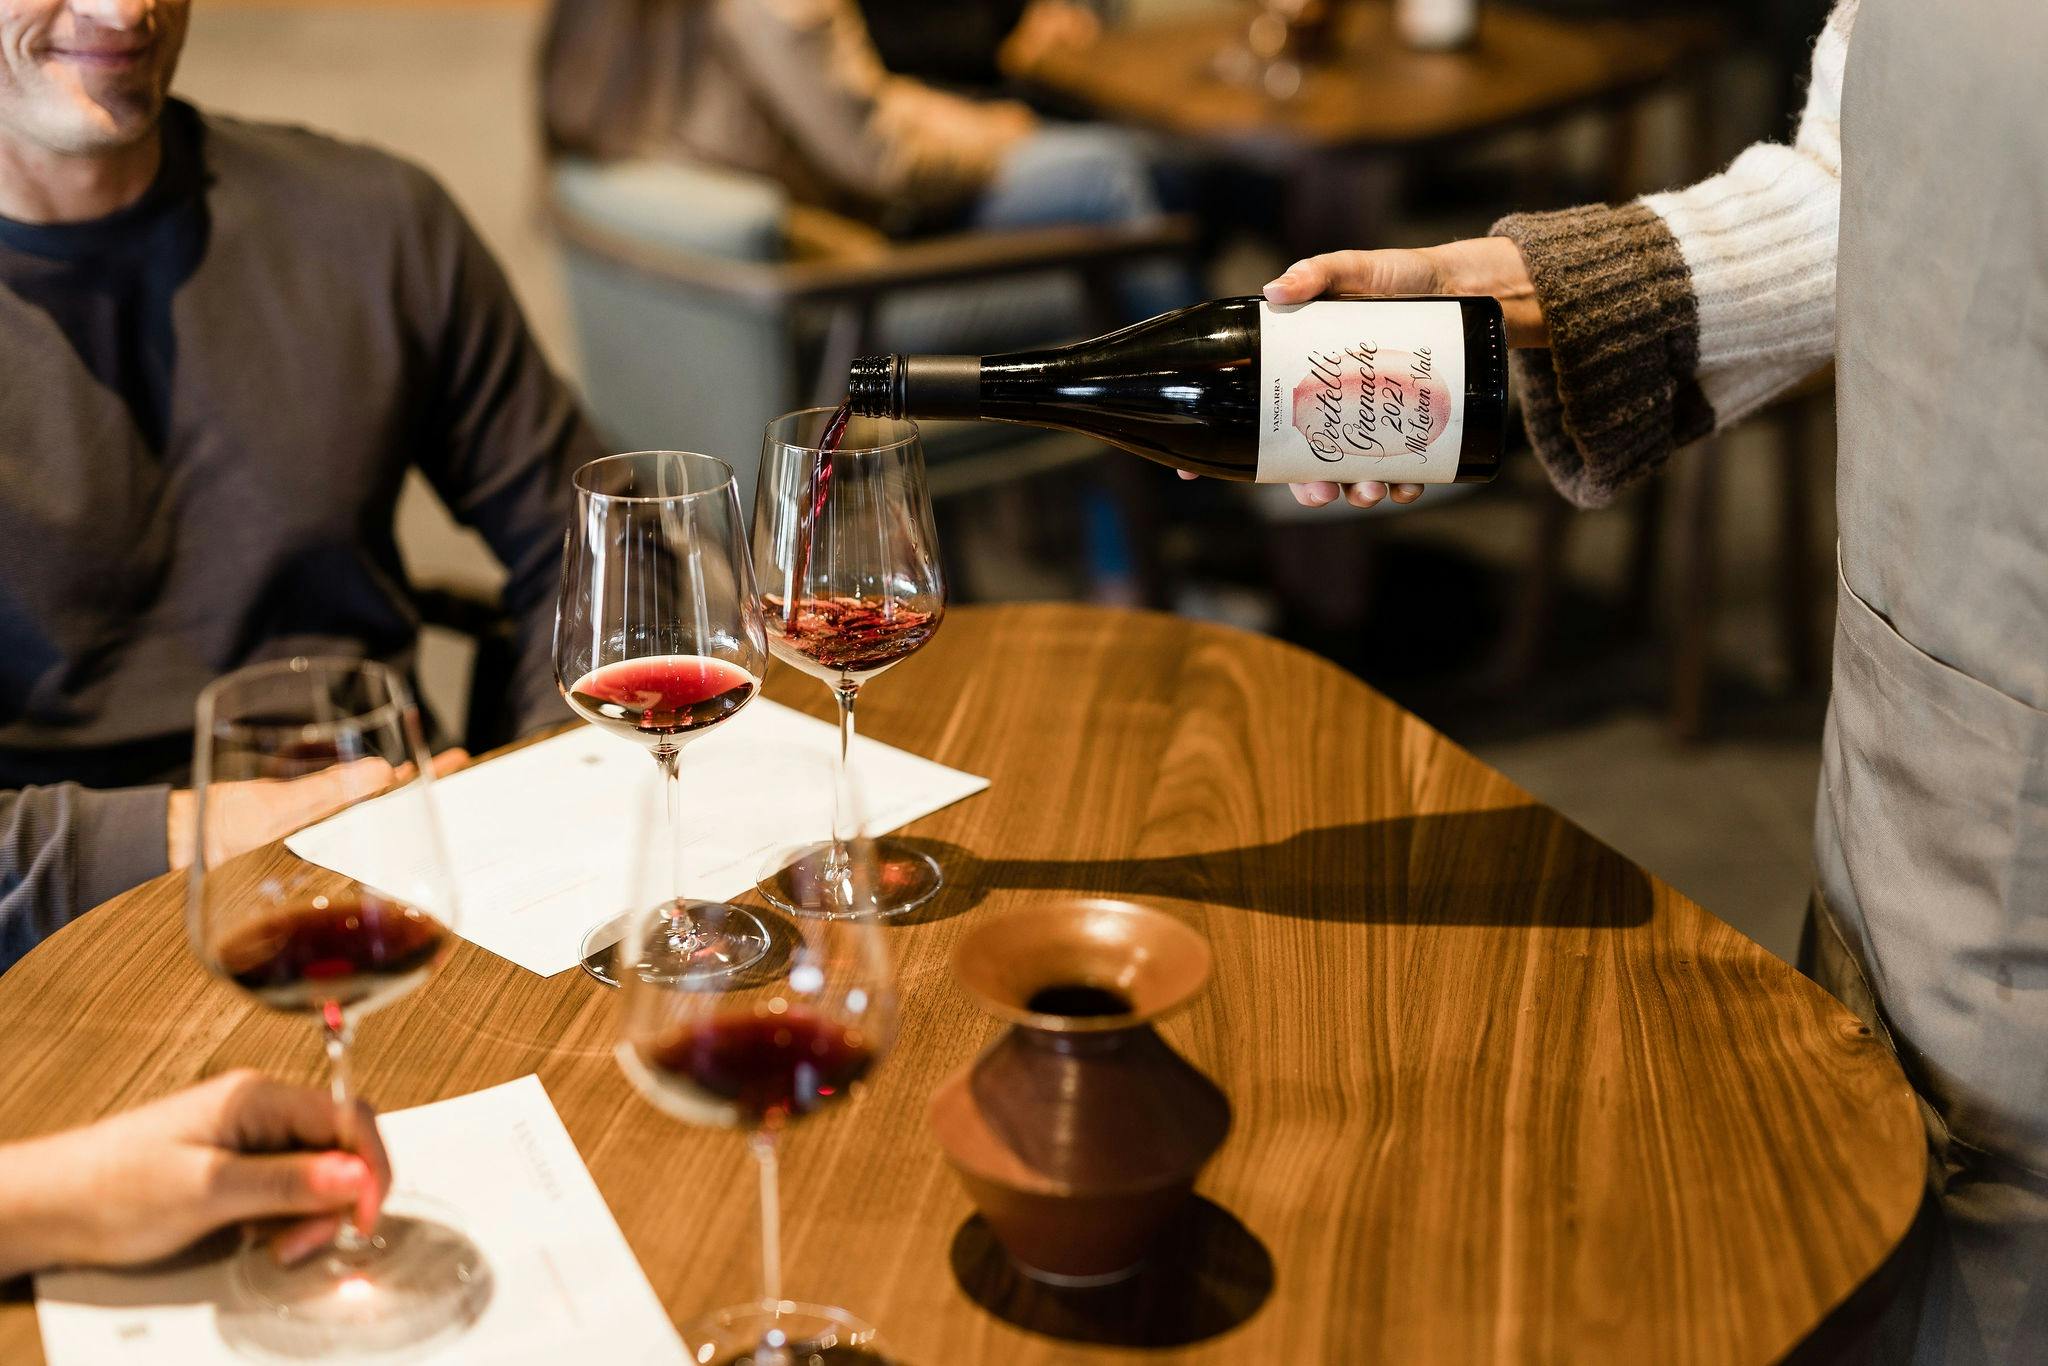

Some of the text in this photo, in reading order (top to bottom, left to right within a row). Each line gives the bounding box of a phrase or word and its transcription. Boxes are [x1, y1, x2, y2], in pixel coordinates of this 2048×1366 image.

[1342, 340, 1385, 463] Grenache
[1381, 377, 1404, 434] 2021
[1403, 347, 1434, 465] McLaren Vale
